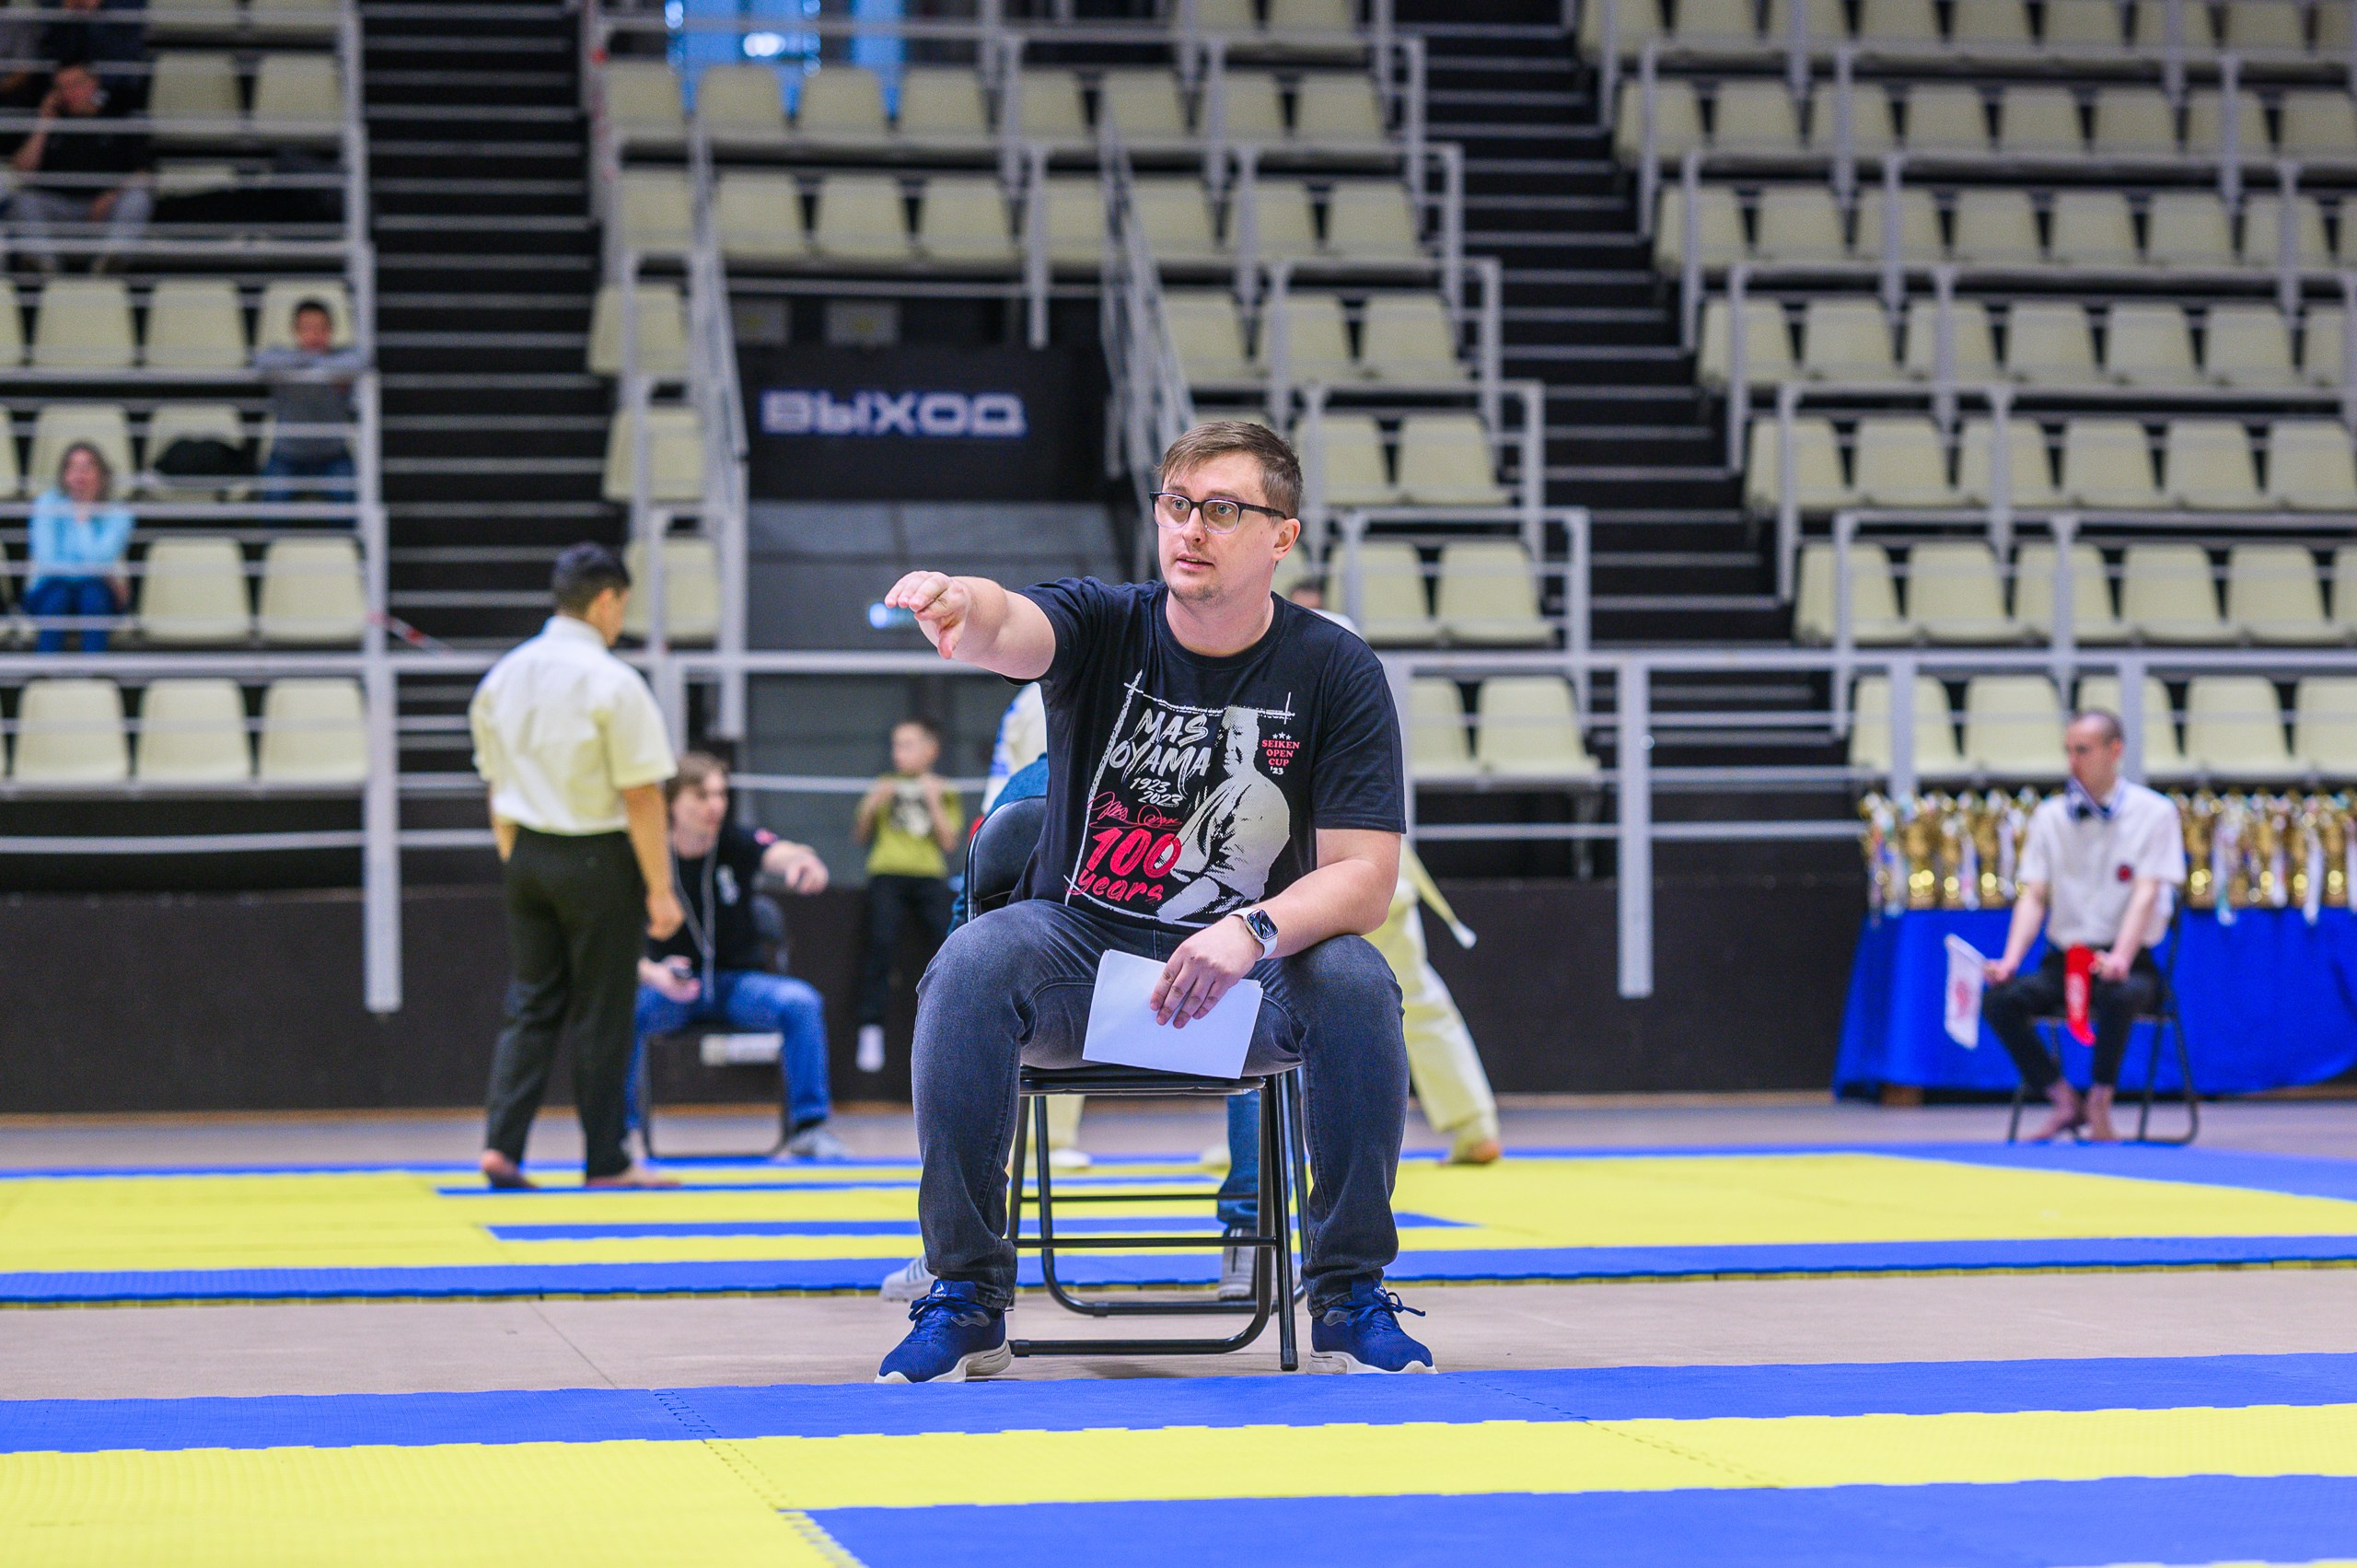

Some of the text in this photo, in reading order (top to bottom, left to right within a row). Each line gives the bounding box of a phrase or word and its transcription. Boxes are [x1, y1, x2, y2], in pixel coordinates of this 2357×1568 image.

[762, 390, 1027, 436] ВЫХОД
[1128, 708, 1208, 748] MAS
[1261, 739, 1300, 749] SEIKEN
[1266, 749, 1294, 758] OPEN
[1109, 740, 1212, 798] OYAMA
[1268, 758, 1289, 766] CUP
[1271, 766, 1284, 775] '23
[1130, 777, 1170, 793] 1923
[1138, 791, 1183, 807] 2023
[1086, 827, 1181, 878] 100
[1065, 868, 1164, 902] years
